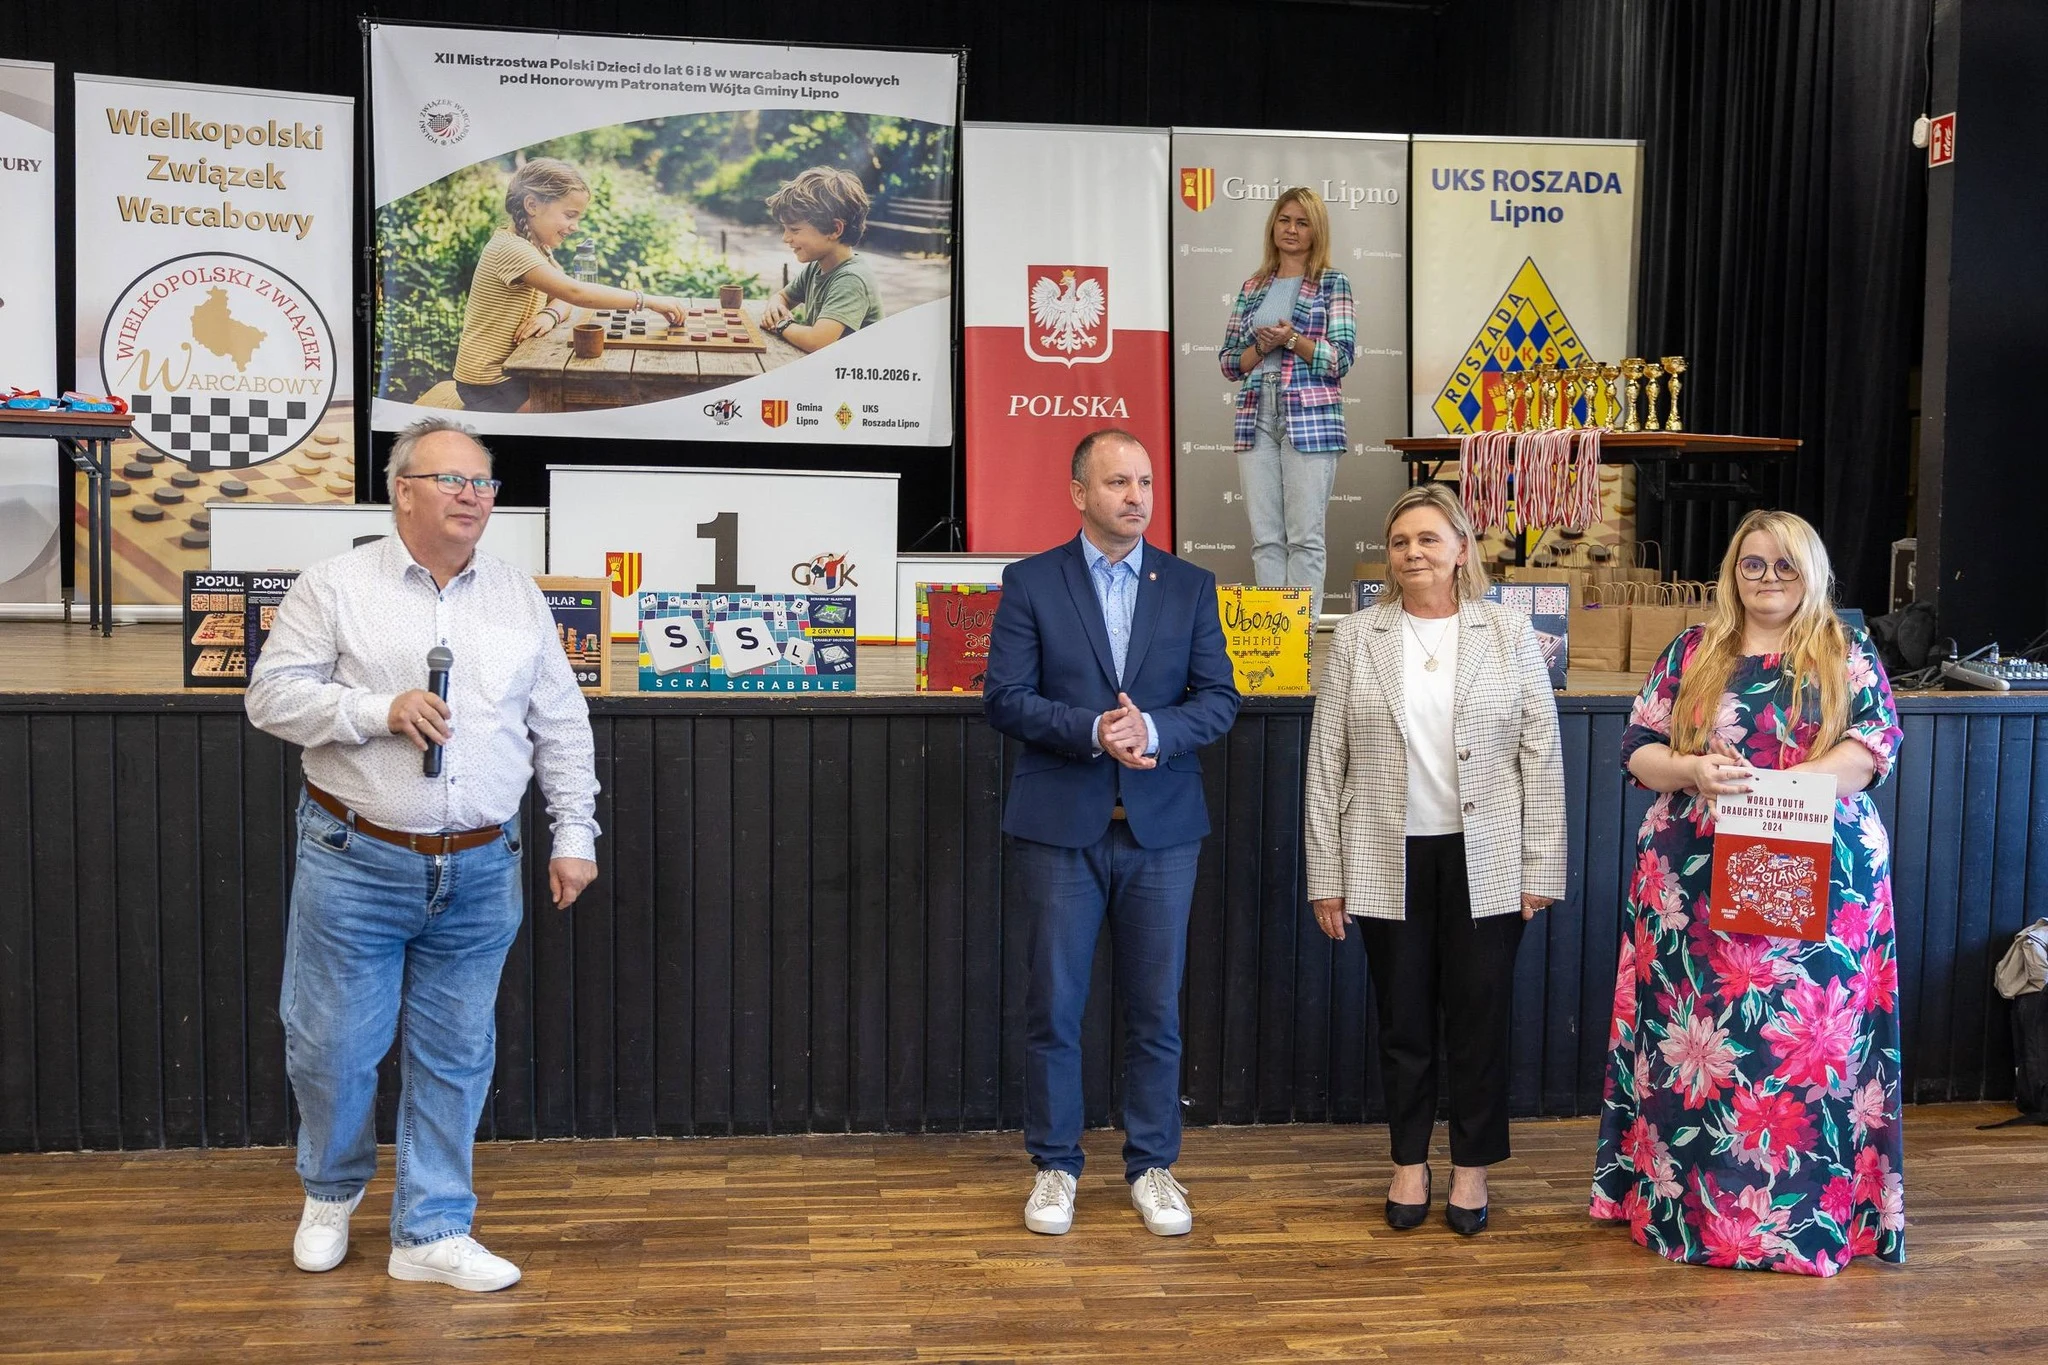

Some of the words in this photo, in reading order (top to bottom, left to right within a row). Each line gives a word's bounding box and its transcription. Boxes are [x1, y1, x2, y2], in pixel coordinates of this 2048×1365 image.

[434, 52, 454, 64] XII
[457, 54, 547, 69] Mistrzostwa
[550, 58, 594, 72] Polski
[597, 61, 641, 74] Dzieci
[643, 63, 661, 75] do
[664, 64, 683, 76] lat
[685, 65, 694, 76] 6
[696, 65, 701, 76] i
[703, 66, 712, 77] 8
[714, 69, 727, 78] w
[729, 70, 807, 82] warcabach
[809, 72, 900, 87] stupolowych
[499, 73, 528, 85] pod
[530, 74, 618, 90] Honorowym
[620, 78, 707, 93] Patronatem
[709, 81, 751, 96] Wójta
[754, 85, 799, 100] Gminy
[801, 87, 840, 100] Lipno
[106, 107, 324, 150] Wielkopolski
[0, 156, 42, 172] URY
[147, 153, 286, 191] Związek
[1431, 168, 1486, 192] UKS
[1492, 169, 1622, 194] ROSZADA
[1322, 179, 1400, 211] Lipno
[117, 195, 314, 240] Warcabowy
[1490, 199, 1564, 228] Lipno
[116, 266, 255, 361] WIELKOPOLSKI
[256, 279, 321, 372] ZWIĄZEK
[1445, 292, 1524, 404] ROSZADA
[1499, 347, 1556, 362] UKS
[117, 341, 323, 395] WARCABOWY
[835, 367, 910, 381] 17-18.10.2026
[912, 371, 921, 382] r.
[796, 402, 823, 413] Gmina
[862, 405, 879, 414] UKS
[1007, 395, 1130, 419] POLSKA
[796, 416, 819, 427] Lipno
[862, 418, 896, 429] Roszada
[897, 419, 920, 429] Lipno
[695, 512, 756, 593] 1
[1225, 600, 1289, 634] Ubongo
[664, 625, 688, 648] S
[736, 626, 759, 650] S
[1232, 636, 1281, 646] SHIMO
[1746, 795, 1774, 806] WORLD
[1777, 798, 1804, 809] YOUTH
[1721, 805, 1763, 819] DRAUGHTS
[1766, 809, 1829, 824] CHAMPIONSHIP
[1762, 822, 1783, 832] 2024
[1752, 862, 1807, 887] POLAND
